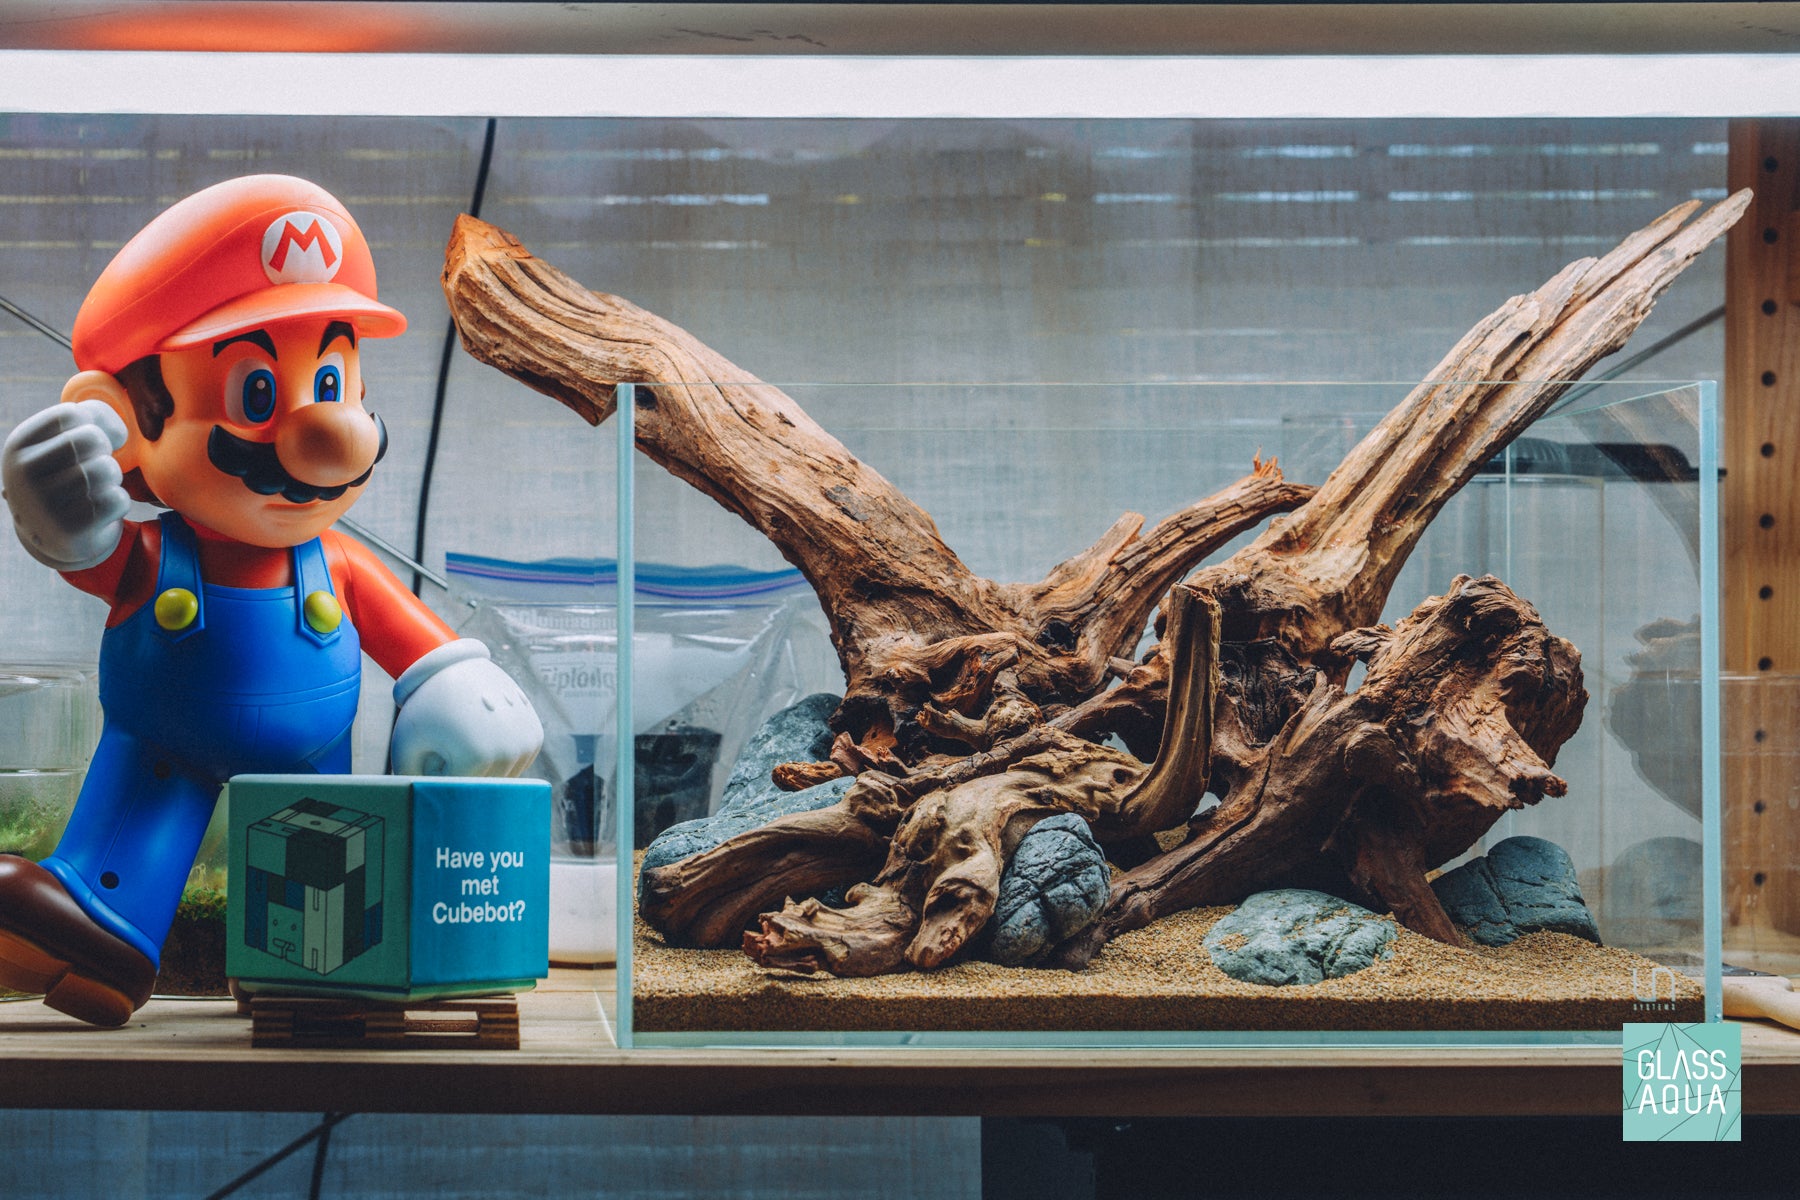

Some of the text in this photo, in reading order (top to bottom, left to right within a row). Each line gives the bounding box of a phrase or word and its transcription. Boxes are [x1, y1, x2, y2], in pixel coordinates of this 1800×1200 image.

[268, 218, 338, 273] M
[436, 847, 524, 873] Have you
[461, 875, 500, 896] met
[432, 899, 526, 925] Cubebot?
